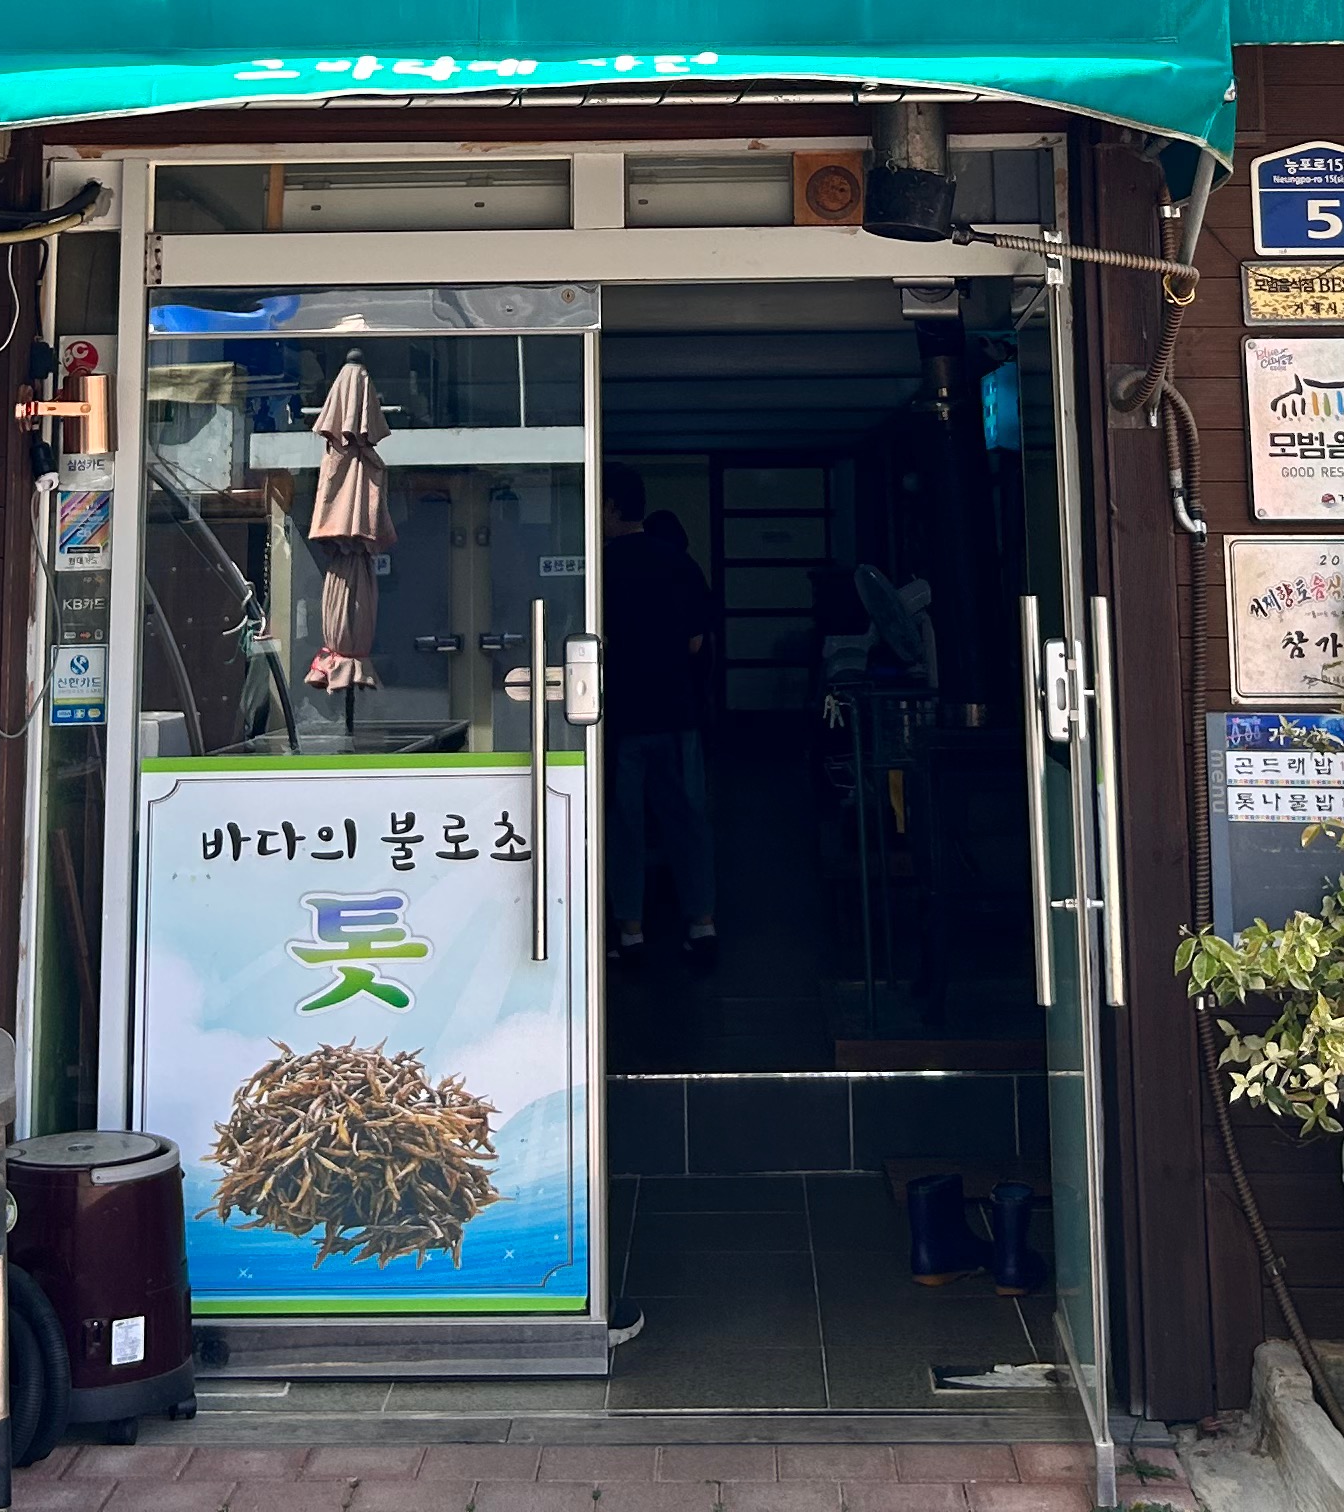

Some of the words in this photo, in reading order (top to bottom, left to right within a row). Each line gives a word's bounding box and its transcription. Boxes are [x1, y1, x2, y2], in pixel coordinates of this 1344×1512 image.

[1307, 199, 1343, 240] 5
[1253, 277, 1314, 294] 모범음식점
[1281, 467, 1315, 478] GOOD
[63, 598, 105, 611] KB카드
[57, 677, 102, 689] 신한카드
[1235, 792, 1335, 812] 톳나물밥
[202, 817, 357, 862] 바다의
[381, 810, 532, 872] 불로초
[286, 891, 433, 1016] 톳
